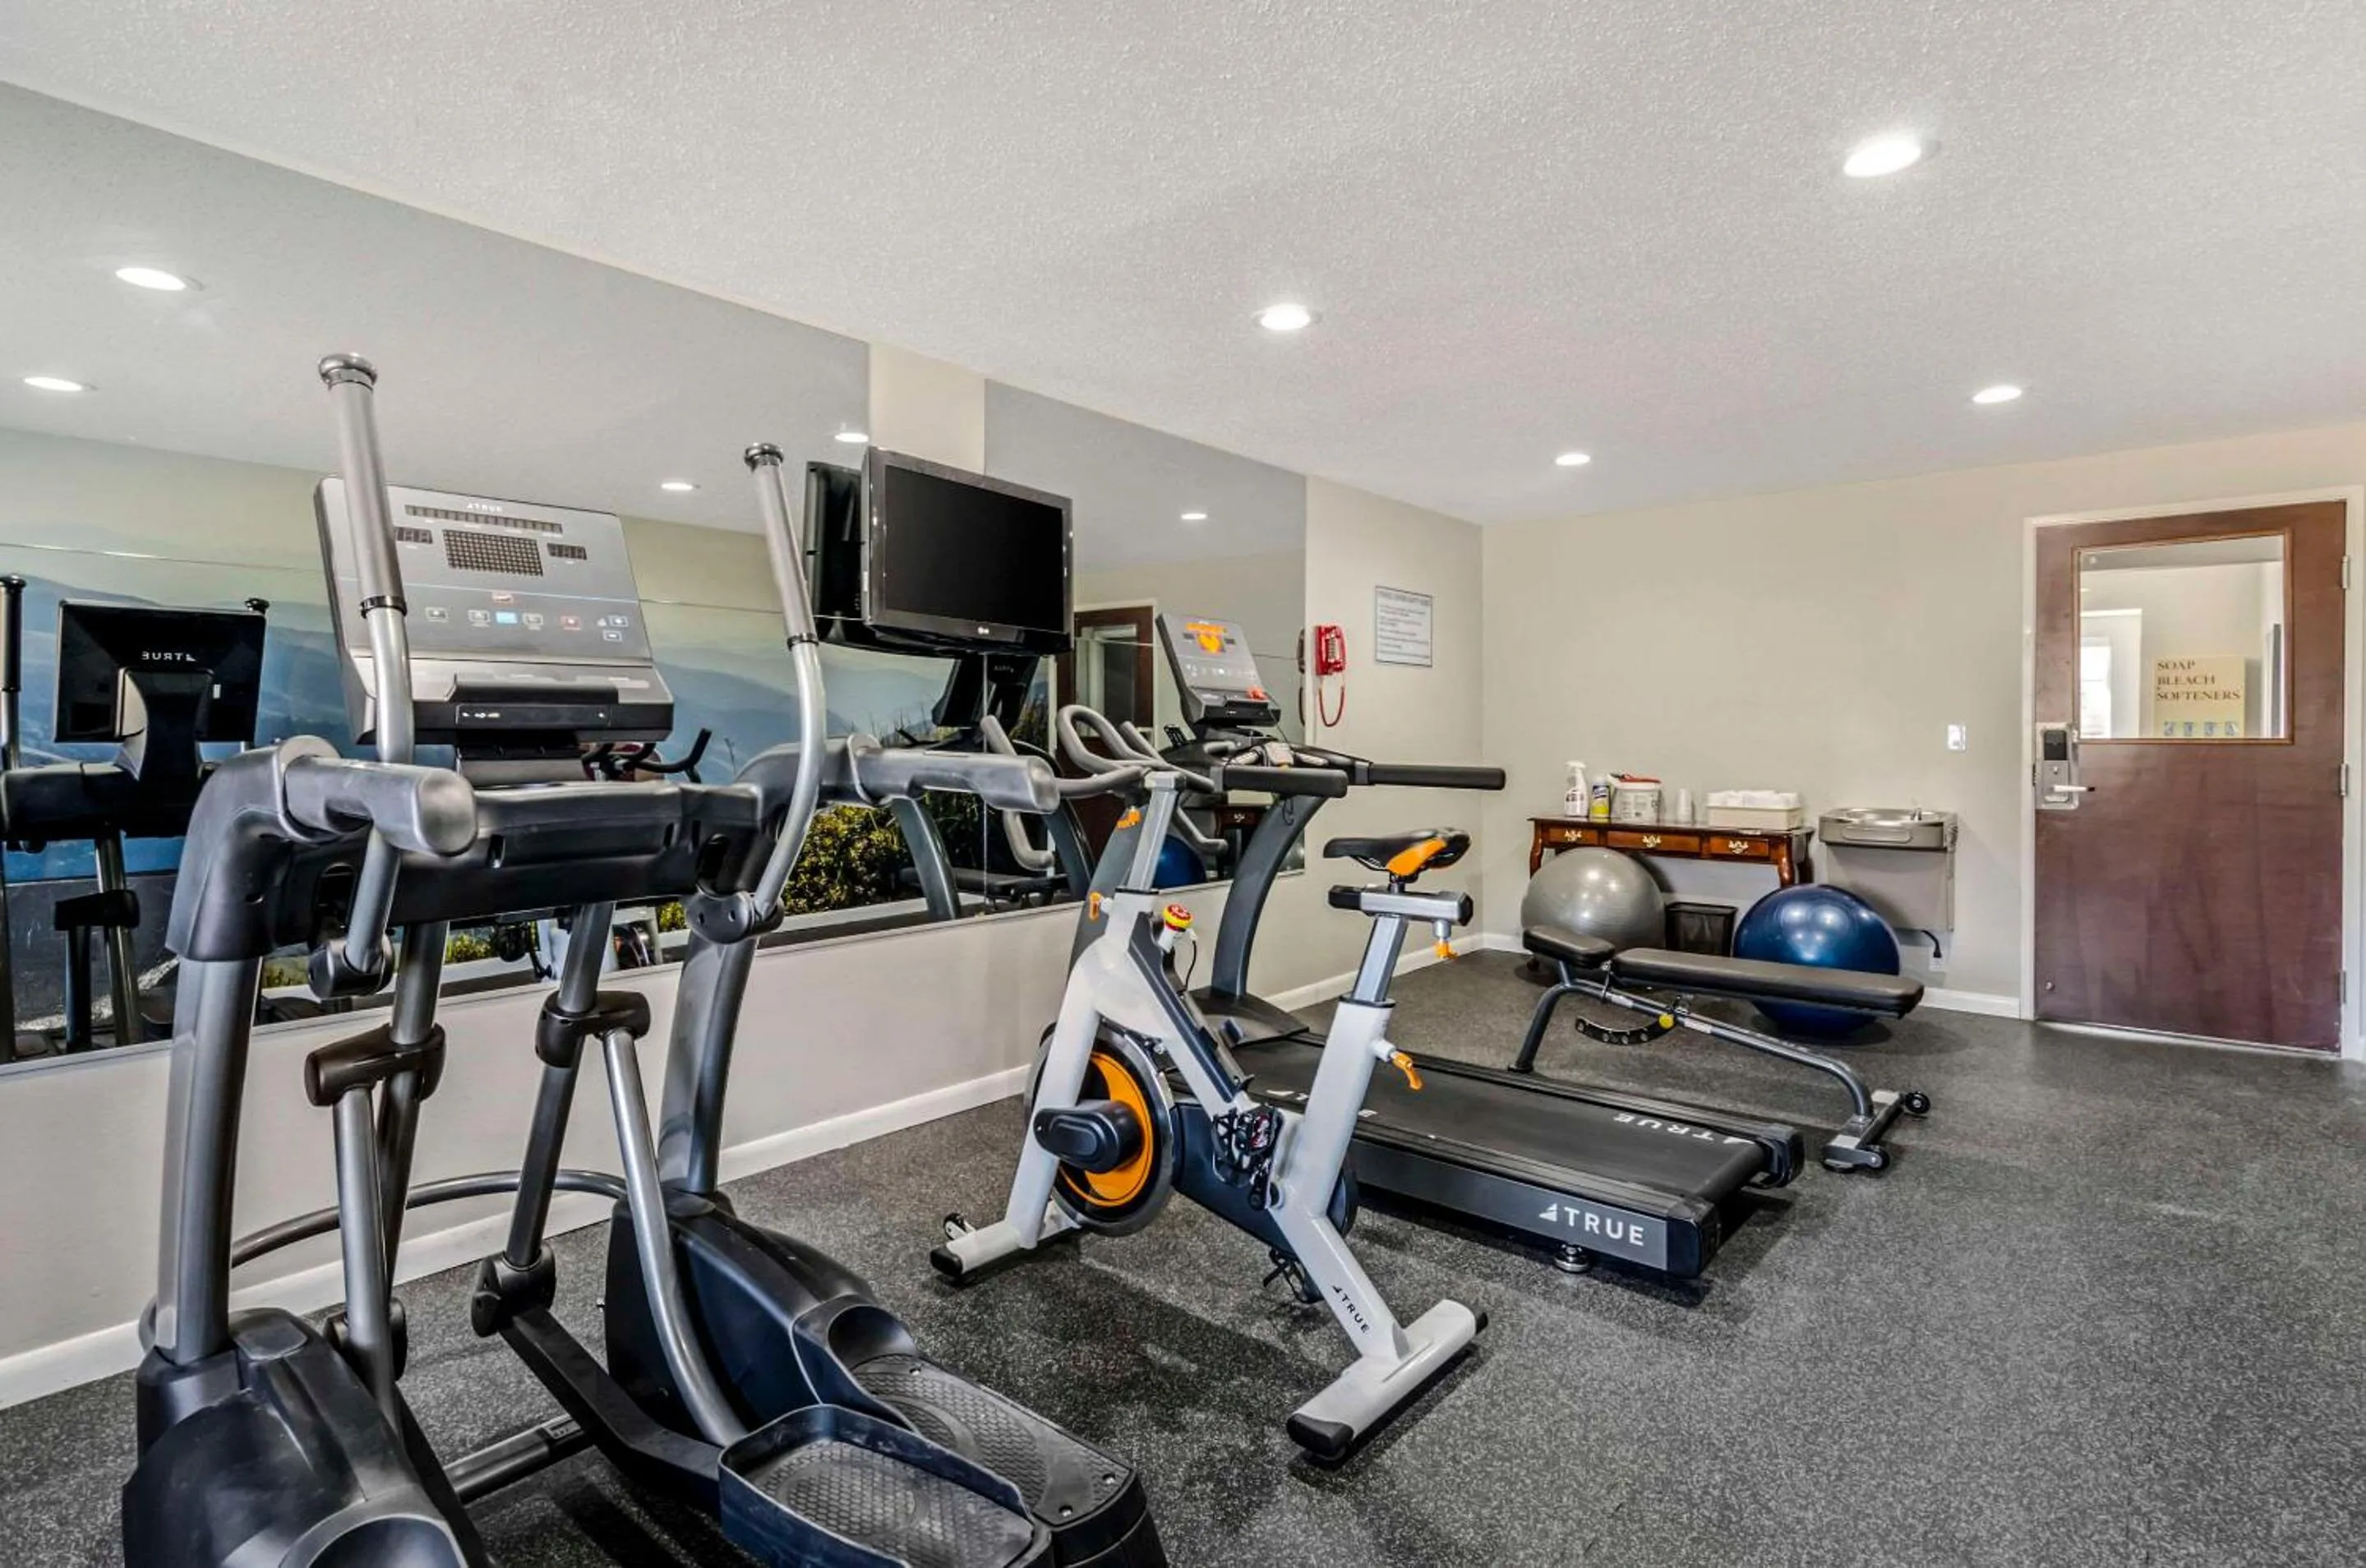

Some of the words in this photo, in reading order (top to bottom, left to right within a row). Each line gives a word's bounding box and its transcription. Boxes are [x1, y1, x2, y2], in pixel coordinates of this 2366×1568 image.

[2156, 660, 2196, 671] SOAP
[2156, 675, 2216, 685] BLEACH
[2156, 690, 2241, 701] SOFTENERS
[1613, 1113, 1715, 1141] TRUE
[1563, 1206, 1644, 1247] TRUE
[1341, 1293, 1370, 1333] TRUE
